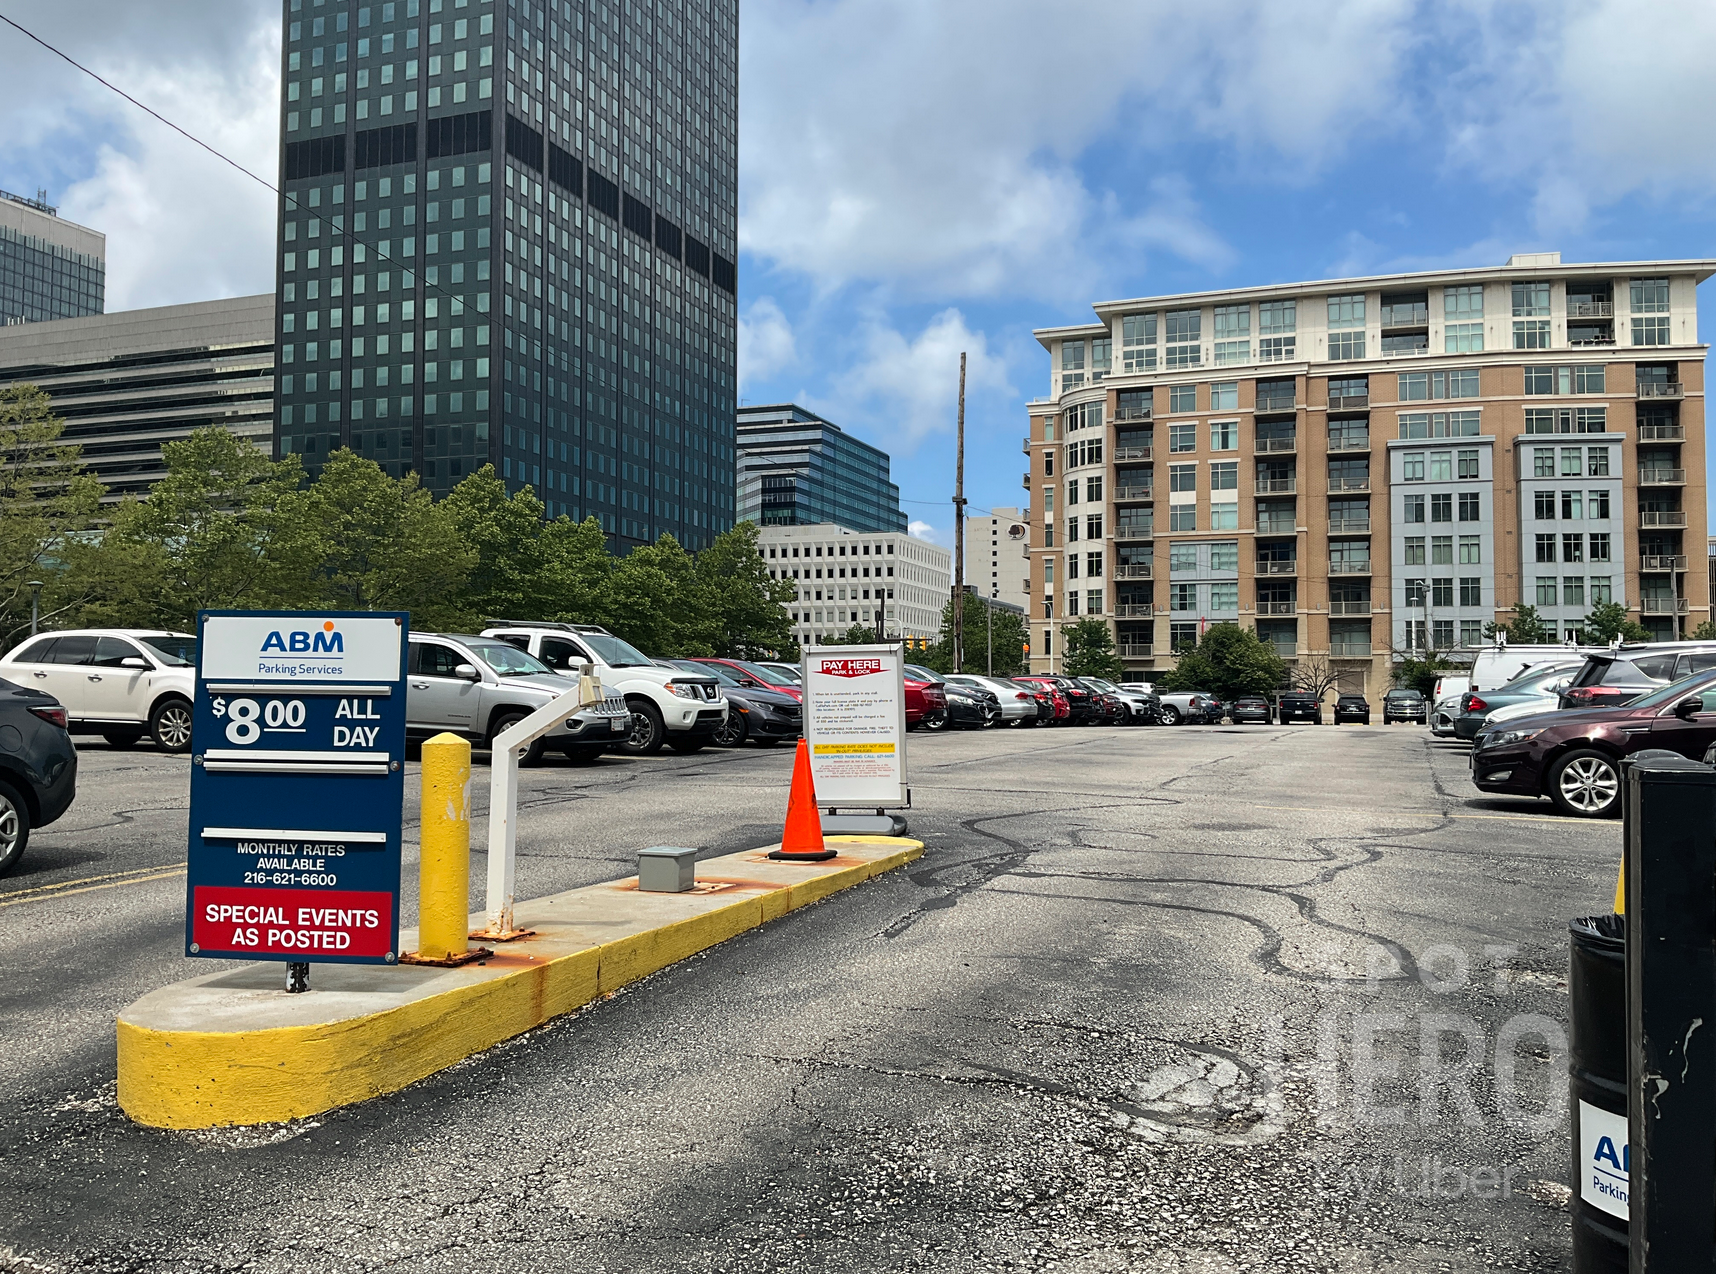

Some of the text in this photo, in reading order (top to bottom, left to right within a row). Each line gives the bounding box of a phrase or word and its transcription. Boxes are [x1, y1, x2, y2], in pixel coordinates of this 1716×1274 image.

[260, 621, 344, 652] ABM
[258, 664, 343, 676] Parking Services
[823, 661, 879, 670] PAY HERE
[335, 699, 380, 719] ALL
[333, 726, 380, 747] DAY
[237, 843, 345, 857] MONTHLY RATES
[257, 858, 325, 870] AVAILABLE
[244, 872, 336, 886] 216-621-6600
[206, 904, 378, 928] SPECIAL EVENTS
[231, 928, 350, 949] AS POSTED
